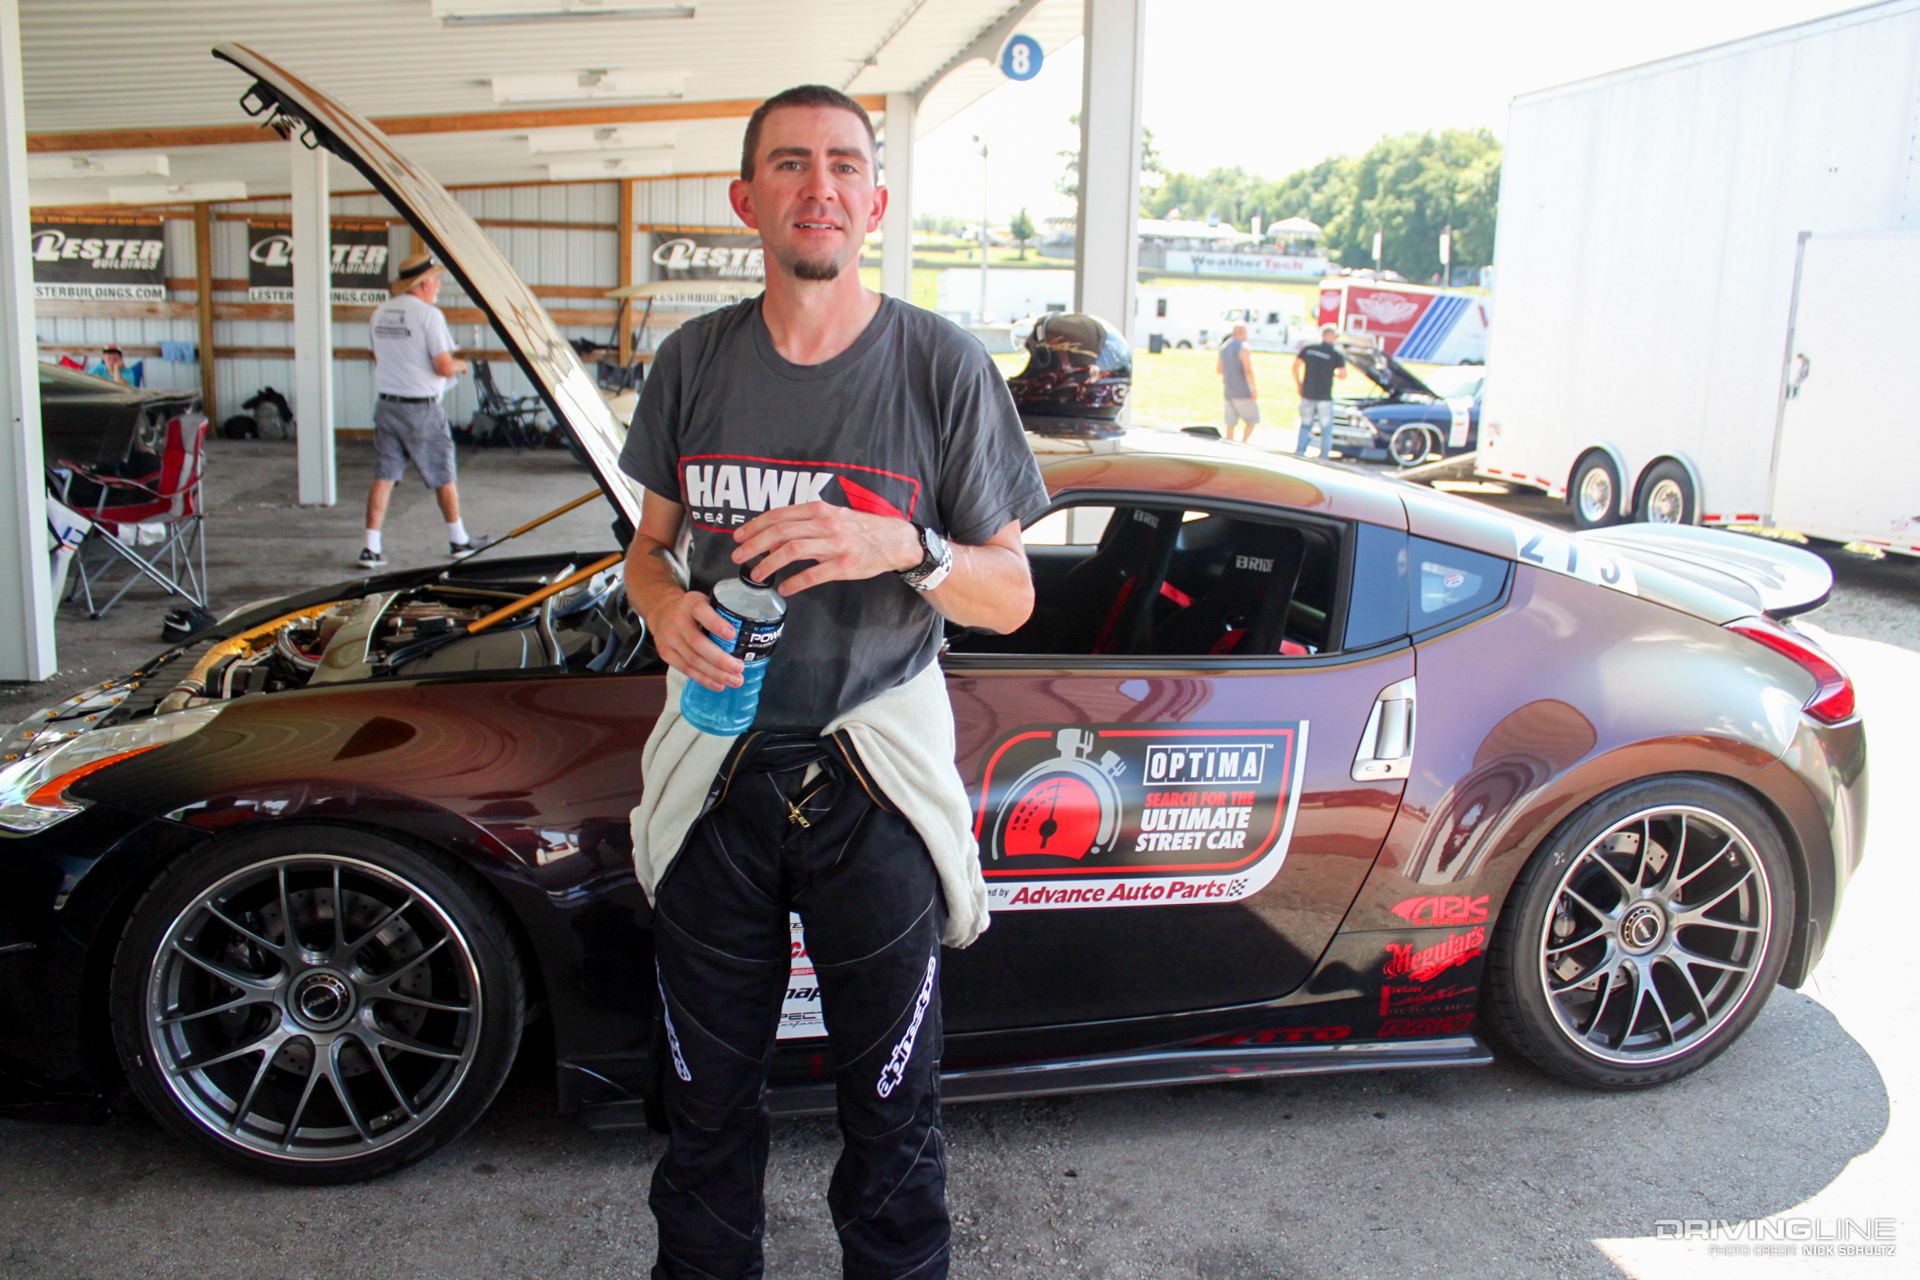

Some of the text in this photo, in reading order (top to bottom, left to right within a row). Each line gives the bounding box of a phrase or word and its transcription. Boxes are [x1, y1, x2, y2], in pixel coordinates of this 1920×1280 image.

[1012, 43, 1030, 75] 8
[33, 229, 163, 262] LESTER
[653, 238, 765, 270] LESTE
[91, 258, 159, 270] BUILDINGS
[718, 266, 766, 277] BUILDIN
[1190, 255, 1303, 270] WeatherTech
[686, 464, 834, 512] HAWK
[692, 511, 757, 525] PERF
[1150, 751, 1258, 779] OPTIMA
[1145, 791, 1257, 808] SEARCH FOR THE
[1140, 807, 1252, 832] ULTIMATE
[1134, 830, 1247, 852] STREET CAR
[999, 888, 1009, 898] by
[1009, 886, 1104, 905] Advance
[1106, 883, 1165, 902] Auto
[1166, 880, 1226, 899] Parts
[1392, 894, 1490, 920] ARK
[1383, 926, 1486, 976] Meguiar's
[1377, 1013, 1475, 1038] RAYS
